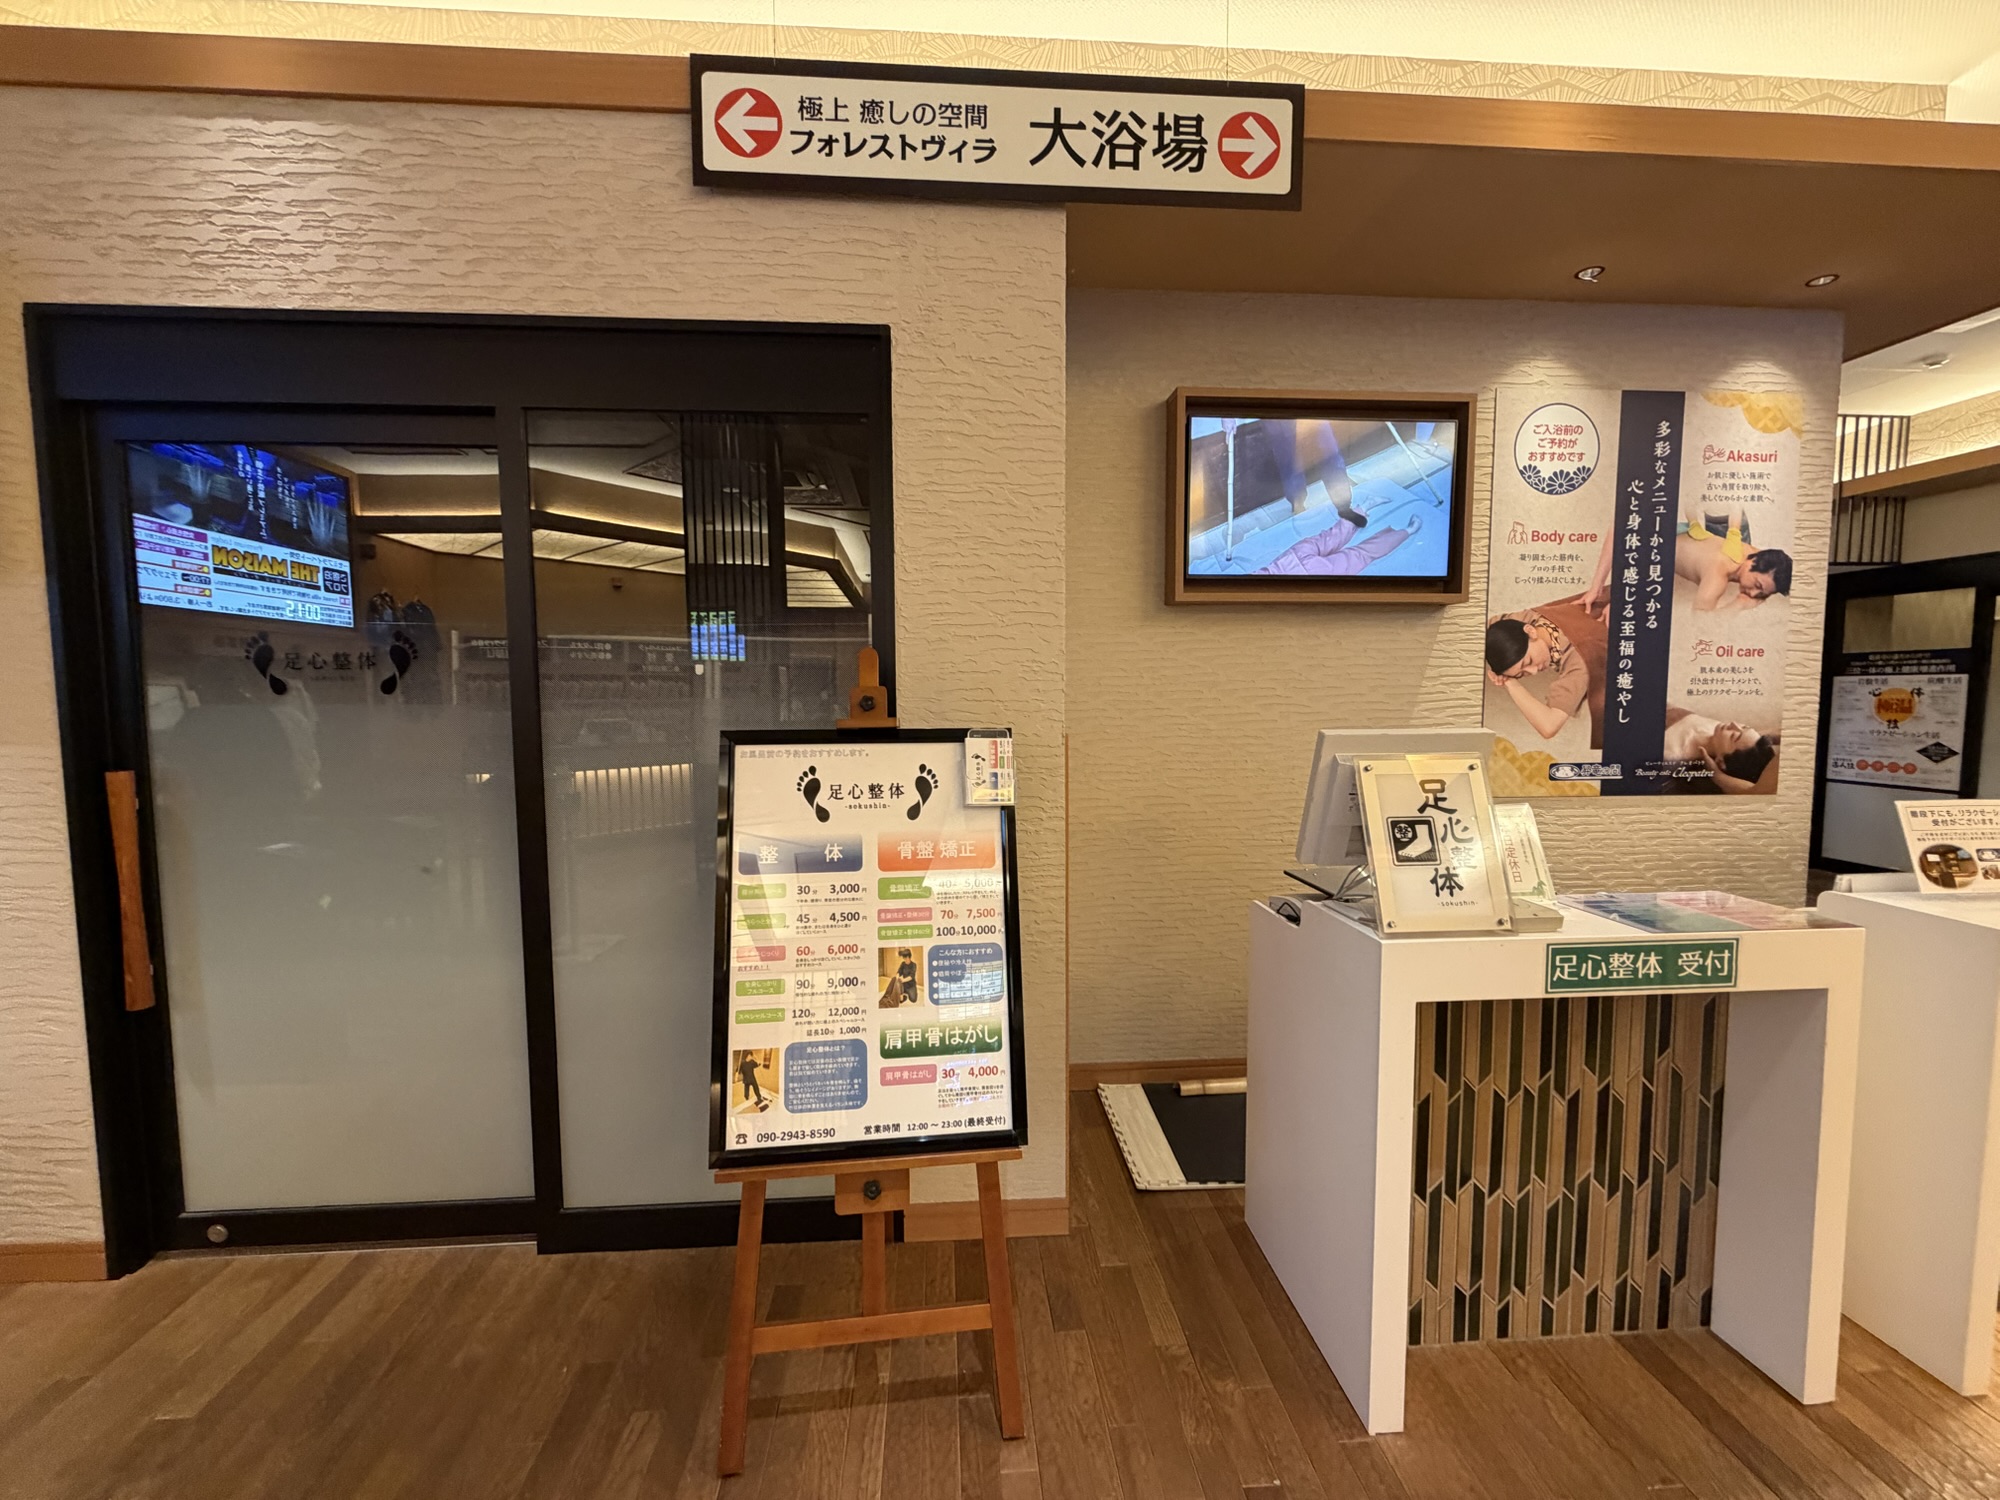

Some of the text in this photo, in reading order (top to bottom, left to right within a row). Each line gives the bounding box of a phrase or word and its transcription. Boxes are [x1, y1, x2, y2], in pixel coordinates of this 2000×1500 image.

[797, 96, 988, 130] 極上 癒しの空間
[790, 129, 998, 165] フォレストヴィラ
[1028, 107, 1209, 174] 大浴場
[1533, 424, 1584, 436] ご入浴前の
[1537, 437, 1578, 449] ご予約が
[1528, 450, 1585, 462] おすすめです
[1726, 450, 1778, 463] Akasuri
[1646, 420, 1671, 629] 多彩なメニューから見つかる
[1531, 530, 1598, 545] Body care
[1616, 479, 1644, 723] 心と身体で感じる至福の癒やし
[1715, 645, 1765, 657] Oil care
[284, 652, 377, 671] 足心整体
[827, 783, 905, 801] 足心整体
[1417, 778, 1477, 898] 足心整体
[1553, 949, 1731, 982] 足心整体 受付
[738, 1012, 783, 1020] スペシャルコース
[885, 1024, 998, 1050] 肩甲骨はがし
[886, 1070, 932, 1080] 肩甲骨はがし
[756, 1127, 836, 1143] 090-2943-8590
[863, 1123, 901, 1136] 営業時間
[907, 1122, 929, 1132] 12:00
[941, 1119, 963, 1130] 23:00
